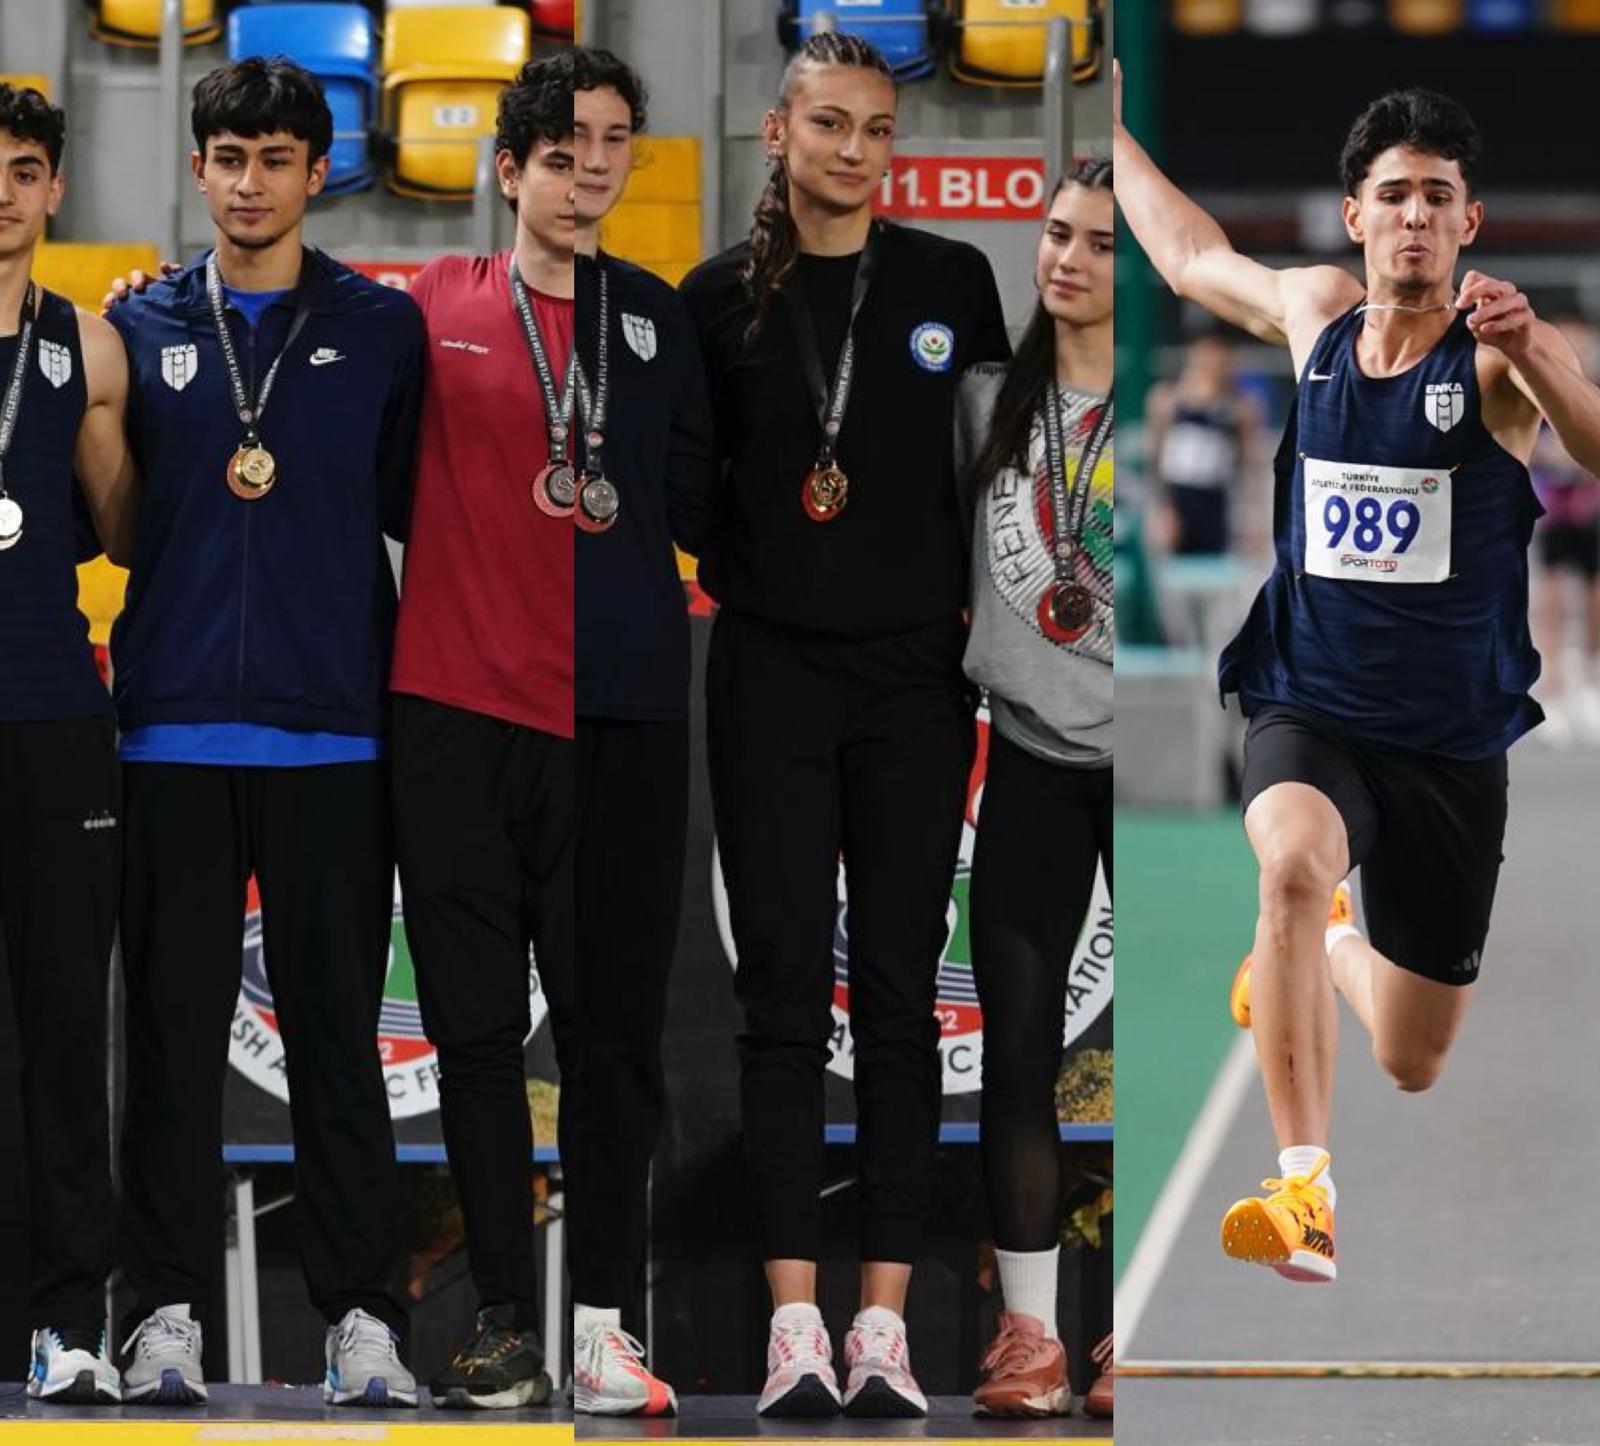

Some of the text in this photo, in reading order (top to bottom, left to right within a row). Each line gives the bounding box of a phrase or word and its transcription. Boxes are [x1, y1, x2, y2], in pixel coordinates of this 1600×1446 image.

[939, 167, 1046, 208] BLO
[1426, 382, 1464, 393] ENKA
[1350, 483, 1418, 495] FEDERASYONU
[1324, 495, 1421, 554] 989
